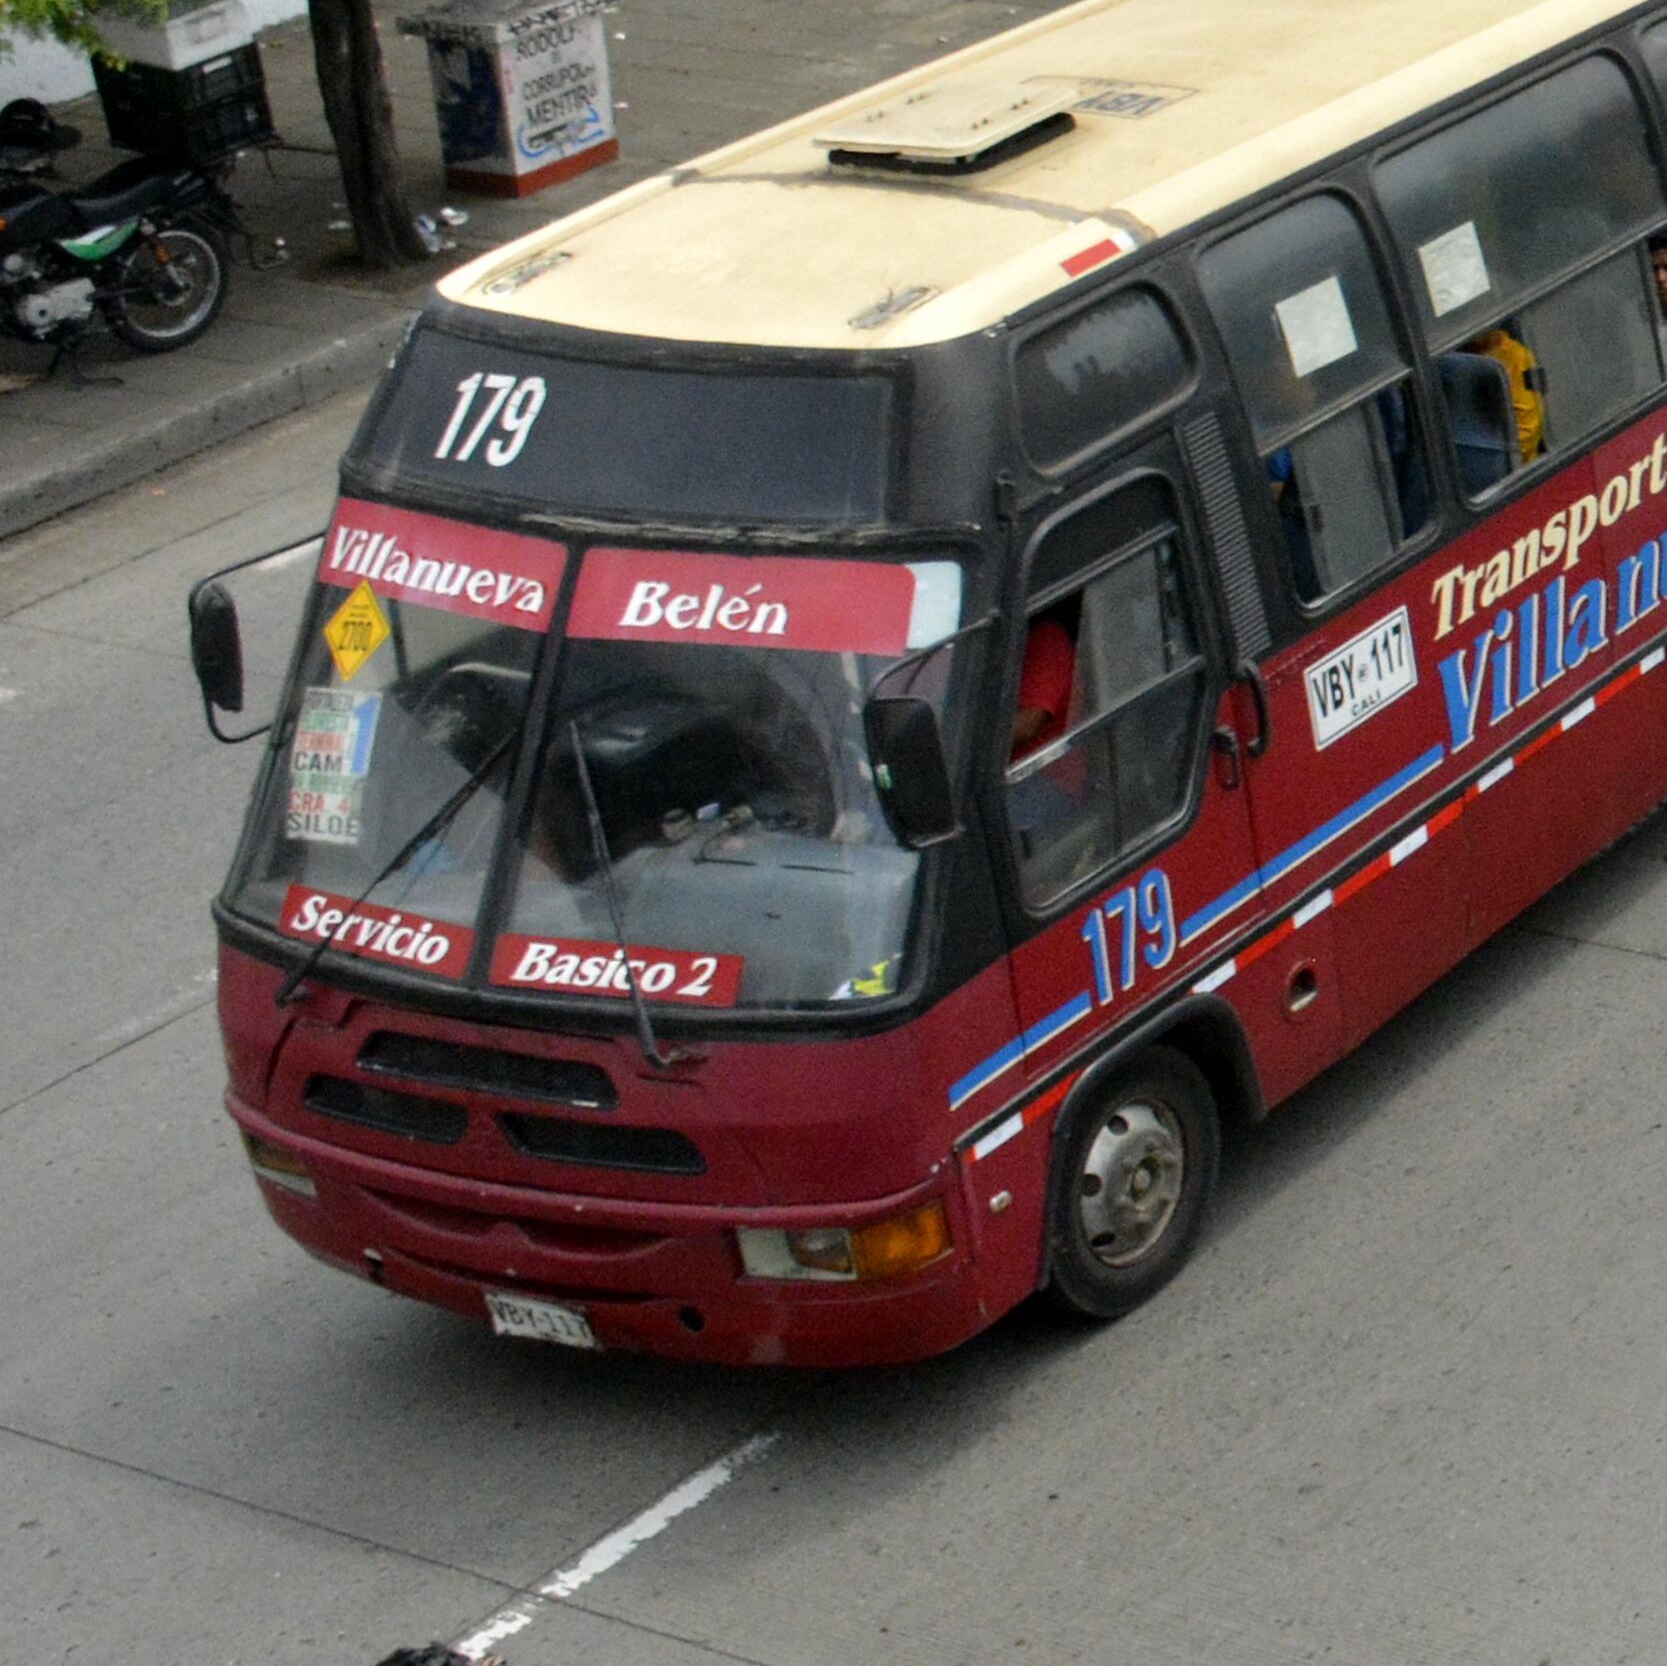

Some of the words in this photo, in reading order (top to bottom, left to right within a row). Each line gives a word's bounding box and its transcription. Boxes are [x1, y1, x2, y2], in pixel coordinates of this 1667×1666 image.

[435, 372, 546, 468] 179
[331, 524, 545, 615] Villanueva
[619, 581, 788, 635] Belén
[1312, 654, 1355, 717] VBY
[1370, 623, 1404, 680] 117
[1352, 689, 1382, 717] CALI
[286, 813, 361, 838] SILOE
[290, 893, 451, 966] Servicio
[1080, 867, 1177, 1007] 179
[510, 942, 676, 996] Basico
[675, 957, 717, 997] 2
